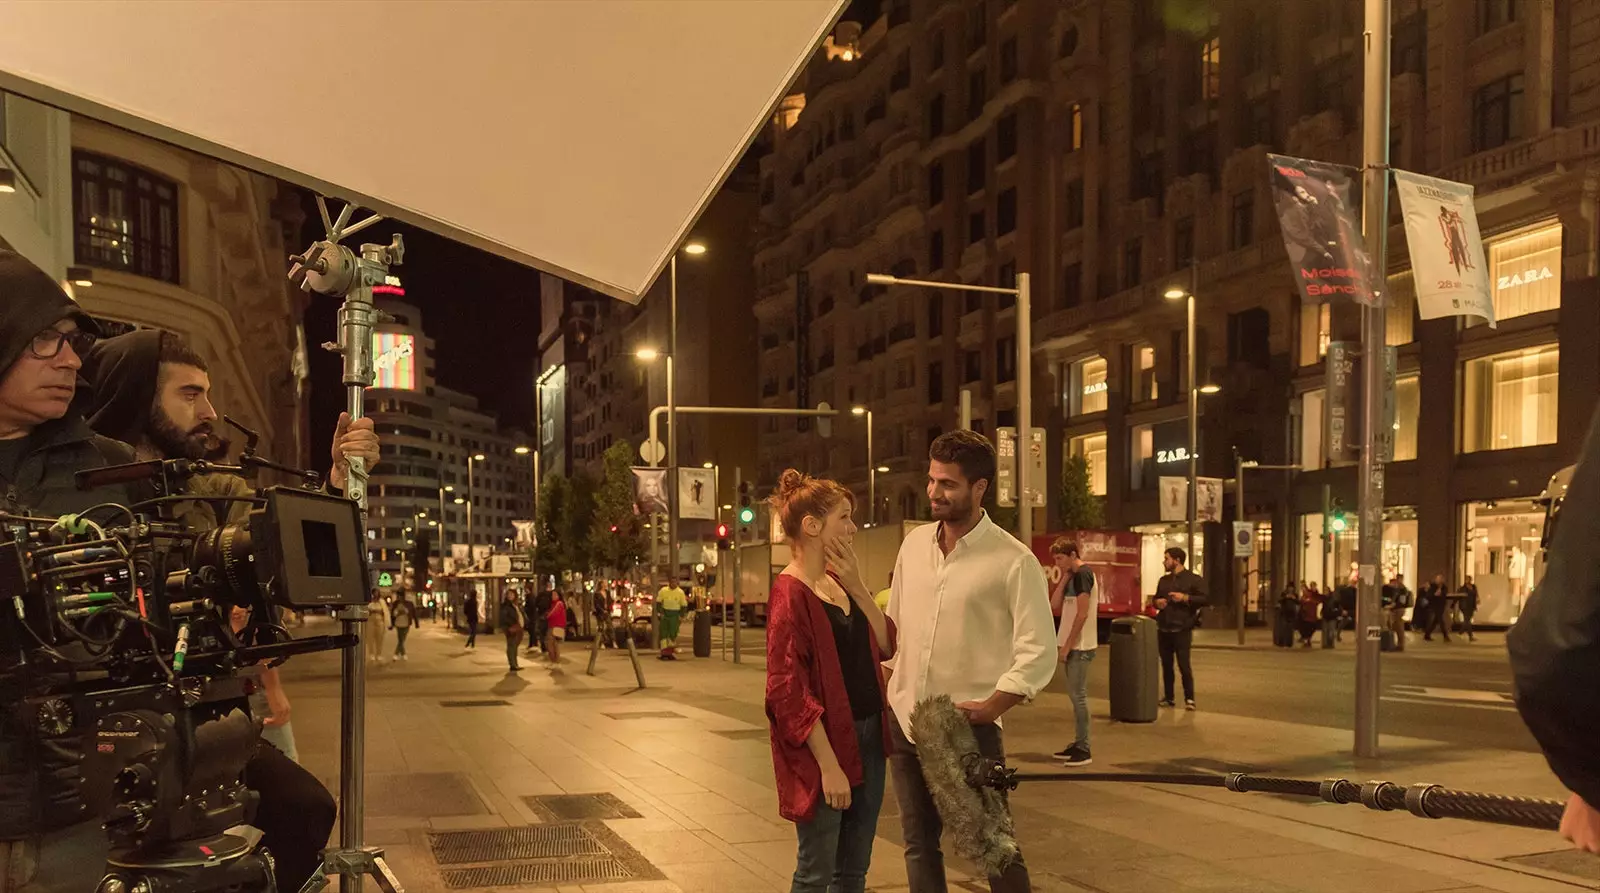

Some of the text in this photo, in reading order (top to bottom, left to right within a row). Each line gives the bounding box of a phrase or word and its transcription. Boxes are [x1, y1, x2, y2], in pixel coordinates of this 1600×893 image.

[1498, 266, 1553, 290] ZARA
[1084, 382, 1107, 394] ZARA
[1043, 565, 1061, 584] PO
